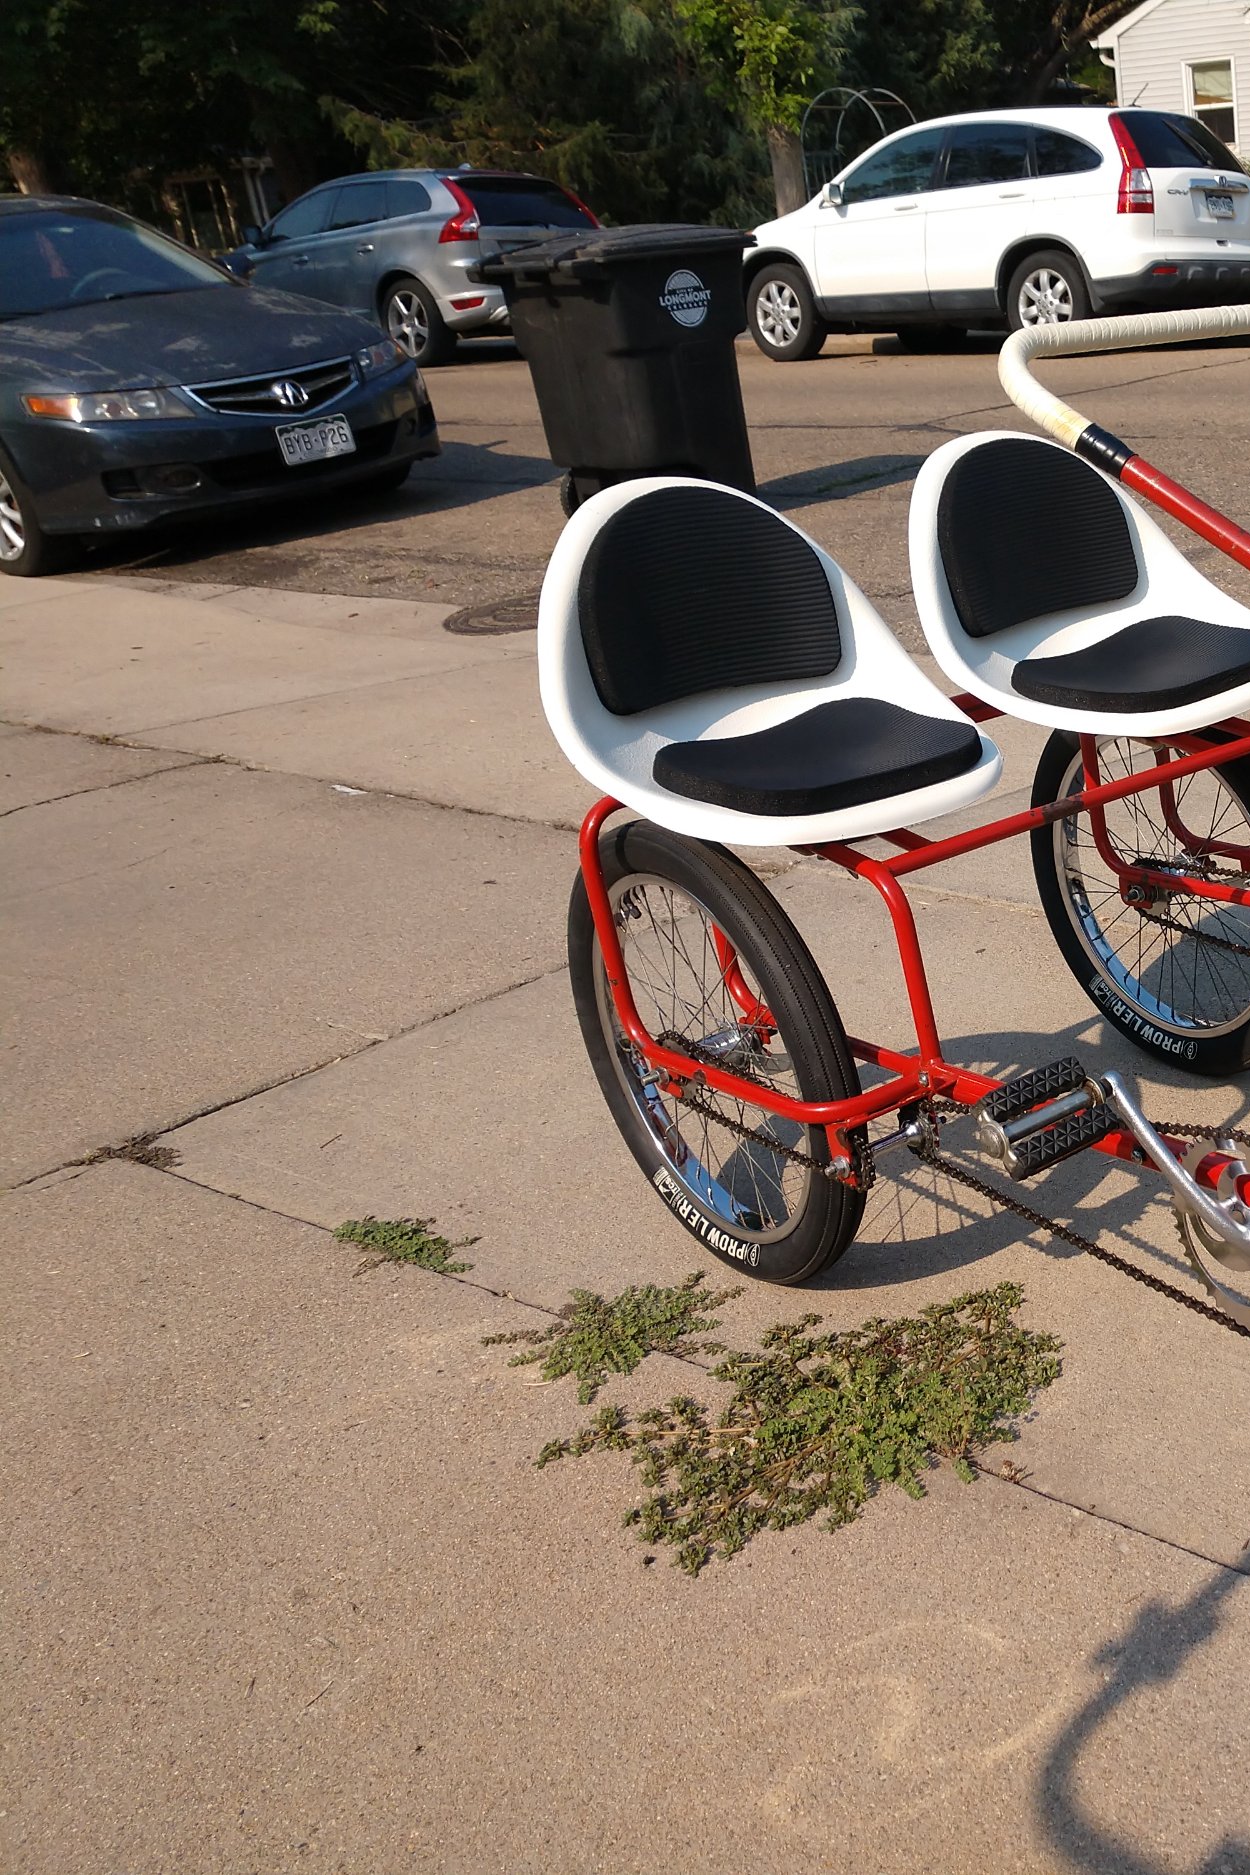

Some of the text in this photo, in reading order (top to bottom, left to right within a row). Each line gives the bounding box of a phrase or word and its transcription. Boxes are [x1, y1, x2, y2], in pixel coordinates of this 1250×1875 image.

[659, 290, 711, 306] LONGMONT
[1112, 999, 1182, 1054] PROWLER
[678, 1196, 746, 1260] PROWLER
